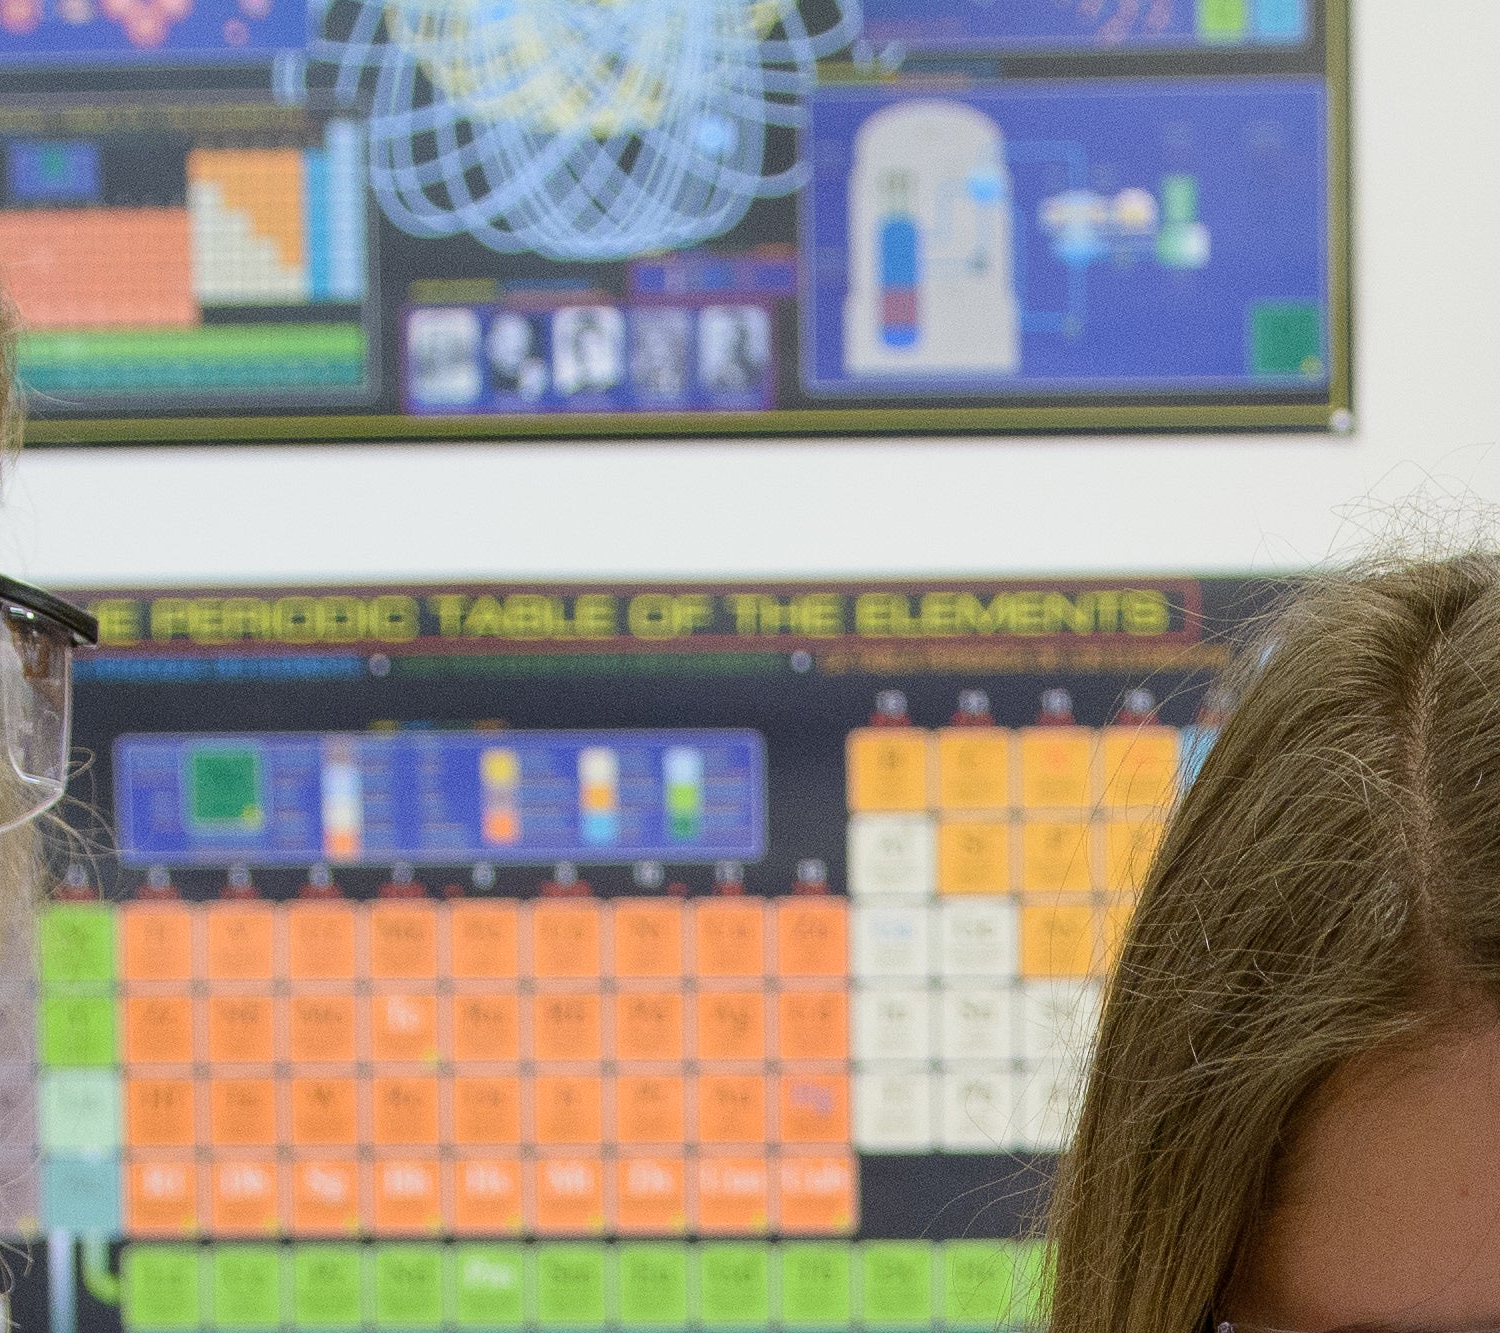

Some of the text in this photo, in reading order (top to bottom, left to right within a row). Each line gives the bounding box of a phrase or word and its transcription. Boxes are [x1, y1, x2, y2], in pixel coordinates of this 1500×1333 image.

[152, 596, 417, 643] PERIODIC
[427, 594, 617, 639] TABLE
[628, 593, 712, 637] OF
[722, 591, 843, 636] THE
[853, 589, 1169, 635] ELEMENTS
